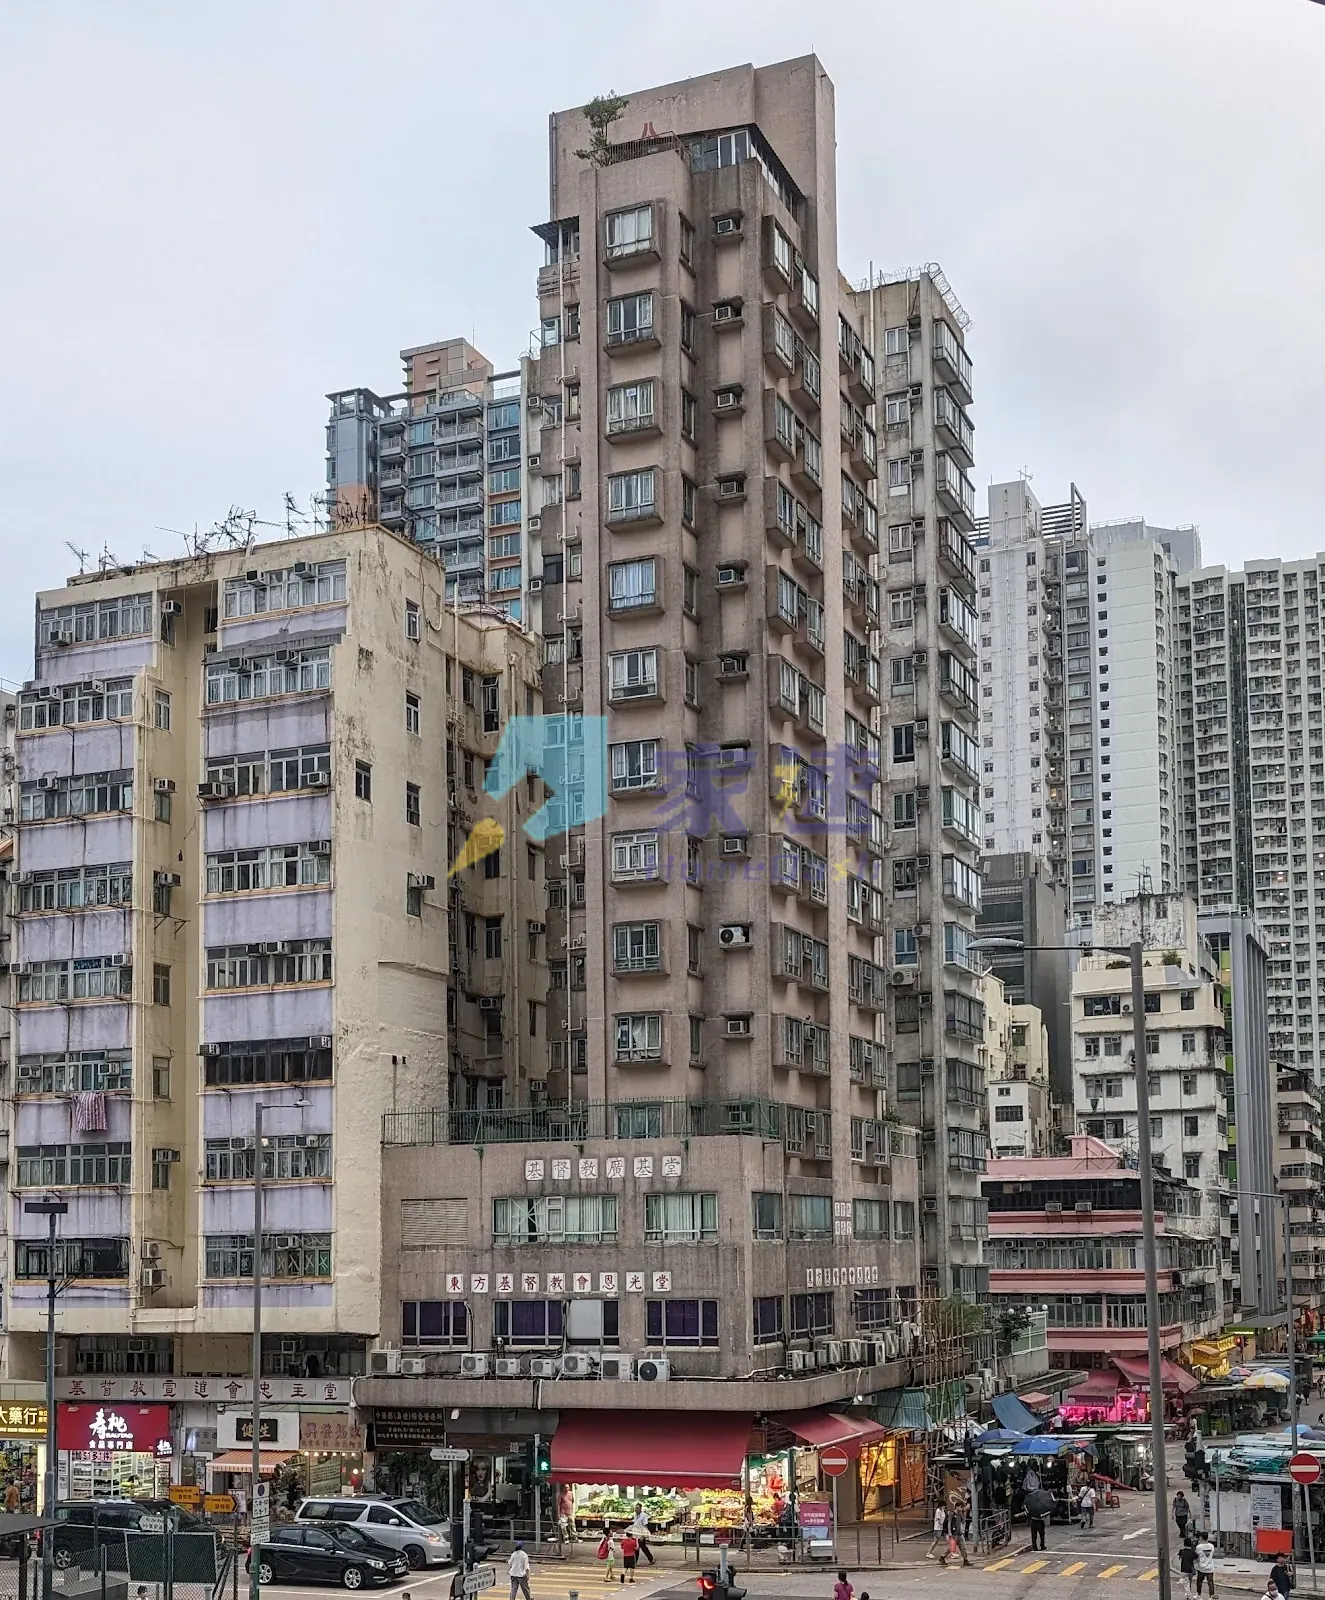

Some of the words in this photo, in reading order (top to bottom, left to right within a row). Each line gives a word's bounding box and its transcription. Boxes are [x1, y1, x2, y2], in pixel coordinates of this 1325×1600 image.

[526, 1156, 681, 1180] 基督教廣基堂
[448, 1272, 670, 1292] 東方基督教會恩光堂
[68, 1379, 338, 1401] 基督教宣道會忠主堂
[88, 1440, 134, 1450] 食品專門店
